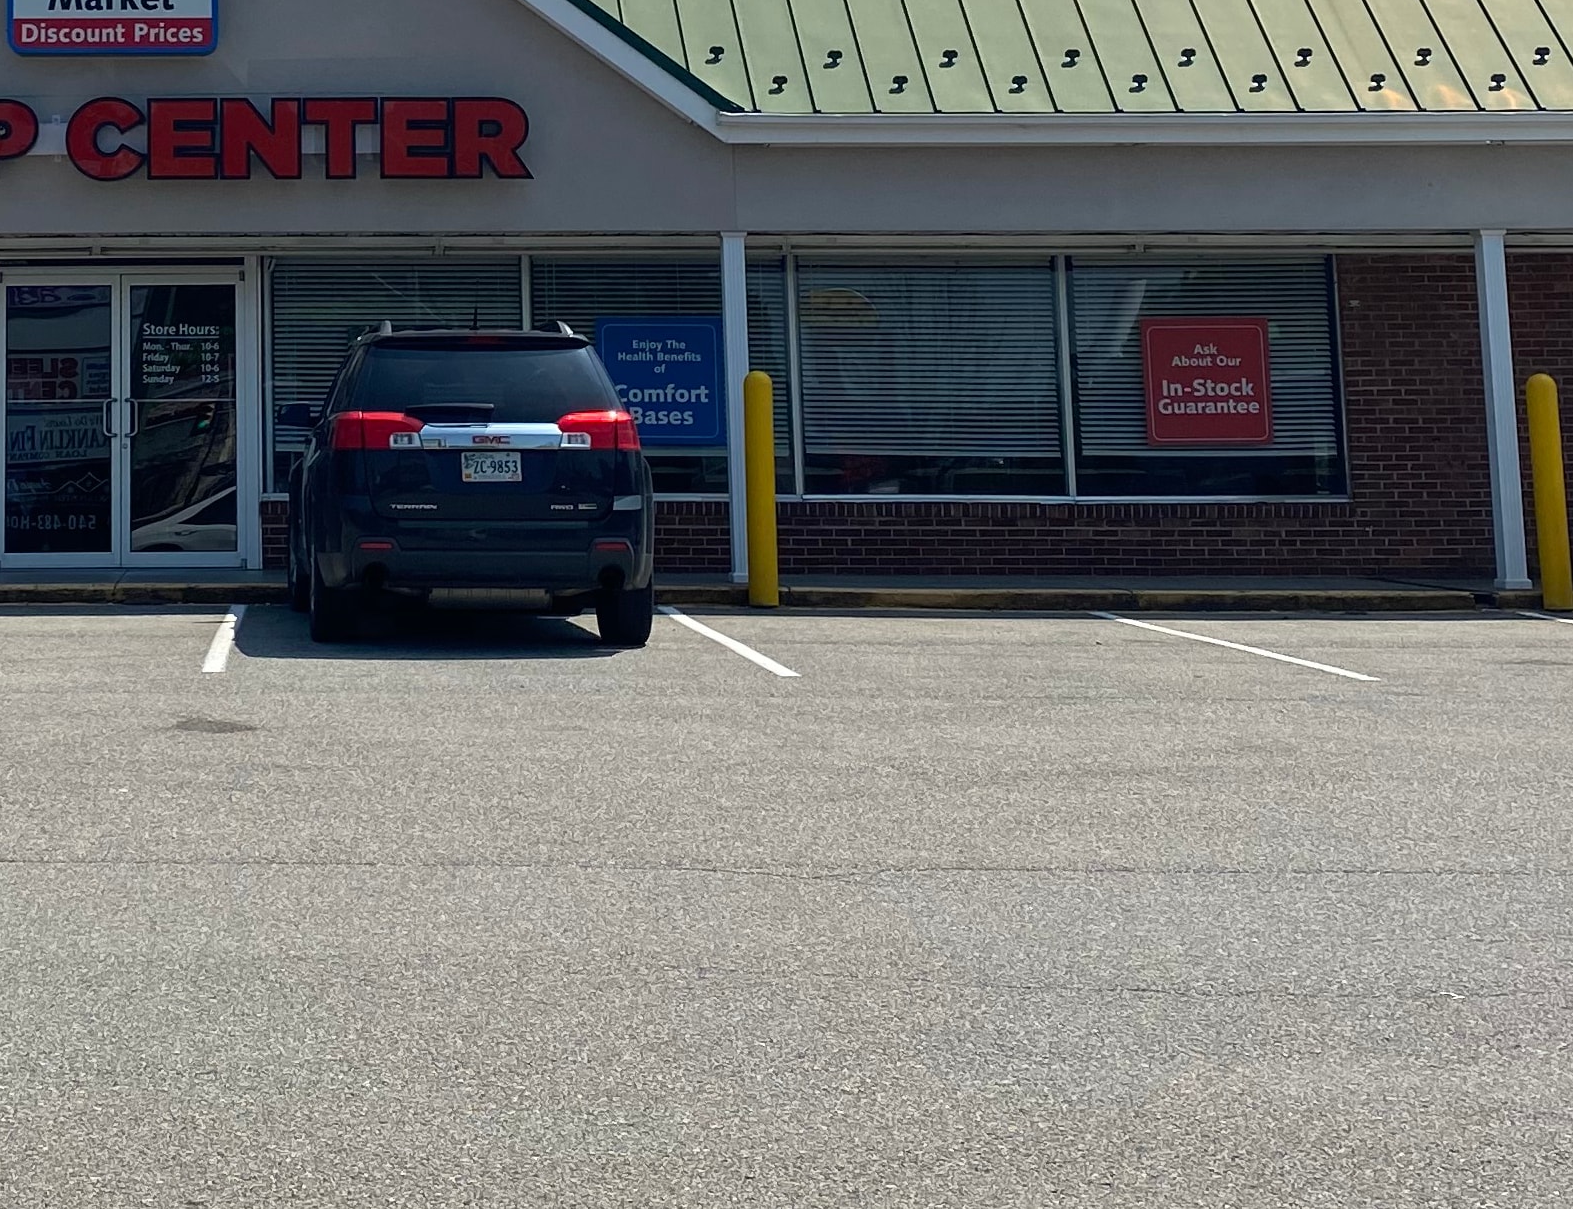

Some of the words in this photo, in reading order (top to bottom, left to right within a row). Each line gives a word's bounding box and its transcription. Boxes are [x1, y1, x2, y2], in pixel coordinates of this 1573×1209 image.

[20, 22, 126, 44] Discount
[133, 21, 204, 43] Prices
[65, 96, 535, 182] CENTER
[142, 322, 177, 335] Store
[179, 323, 220, 335] Hours:
[200, 342, 220, 351] 10-6
[632, 339, 663, 351] Enjoy
[665, 339, 686, 350] The
[1193, 343, 1218, 355] Ask
[142, 352, 169, 363] Friday
[200, 352, 220, 362] 10-7
[617, 352, 654, 361] Health
[656, 352, 702, 362] Benefits
[1171, 355, 1213, 367] About
[1216, 355, 1242, 367] Our
[142, 364, 181, 374] Saturday
[200, 363, 220, 372] 10-6
[653, 363, 666, 374] of
[142, 374, 175, 385] Sunday
[1161, 377, 1255, 397] In-Stock
[1157, 398, 1260, 415] Guarantee
[629, 406, 694, 425] Bases
[472, 435, 511, 444] GMC
